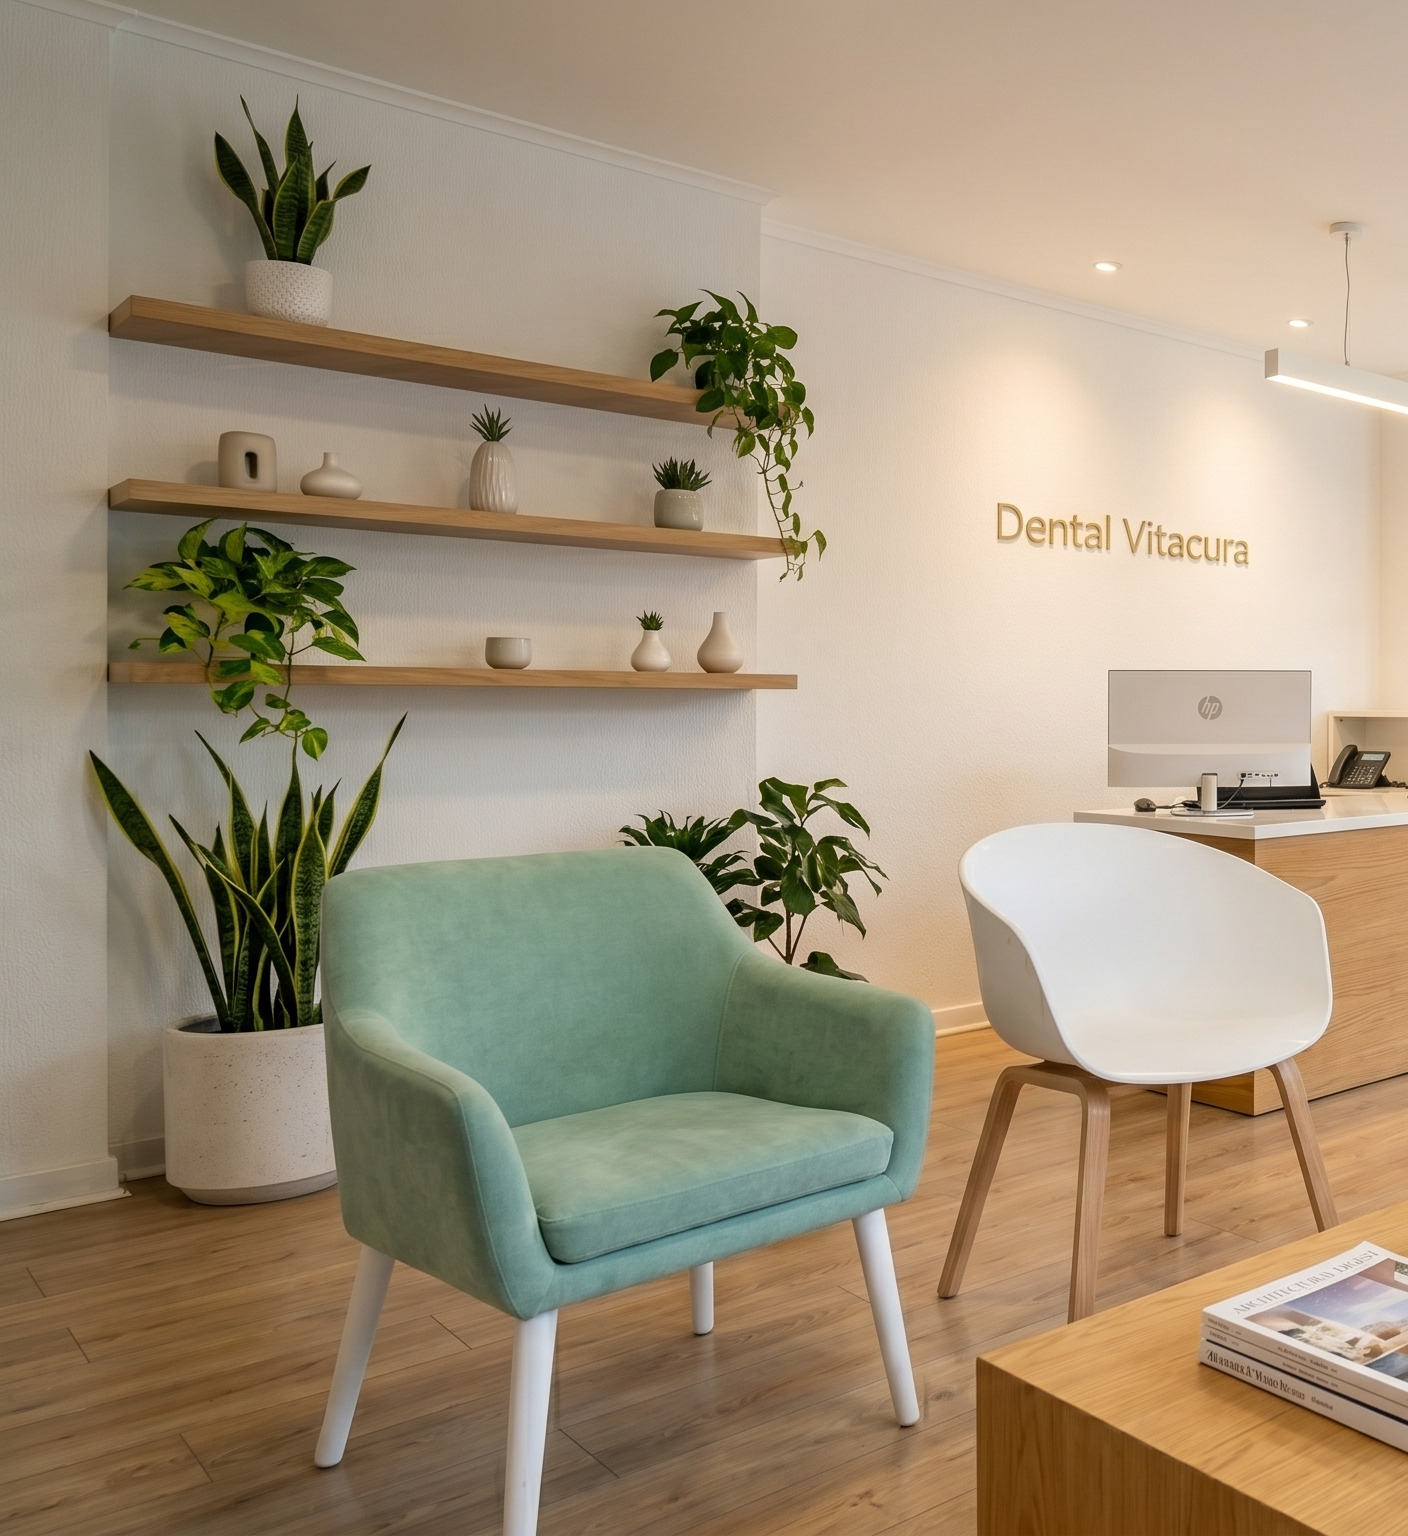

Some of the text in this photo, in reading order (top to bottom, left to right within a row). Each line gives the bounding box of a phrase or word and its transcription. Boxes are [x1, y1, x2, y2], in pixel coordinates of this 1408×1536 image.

[997, 502, 1250, 566] Dental Vitacura
[1199, 695, 1222, 720] hp
